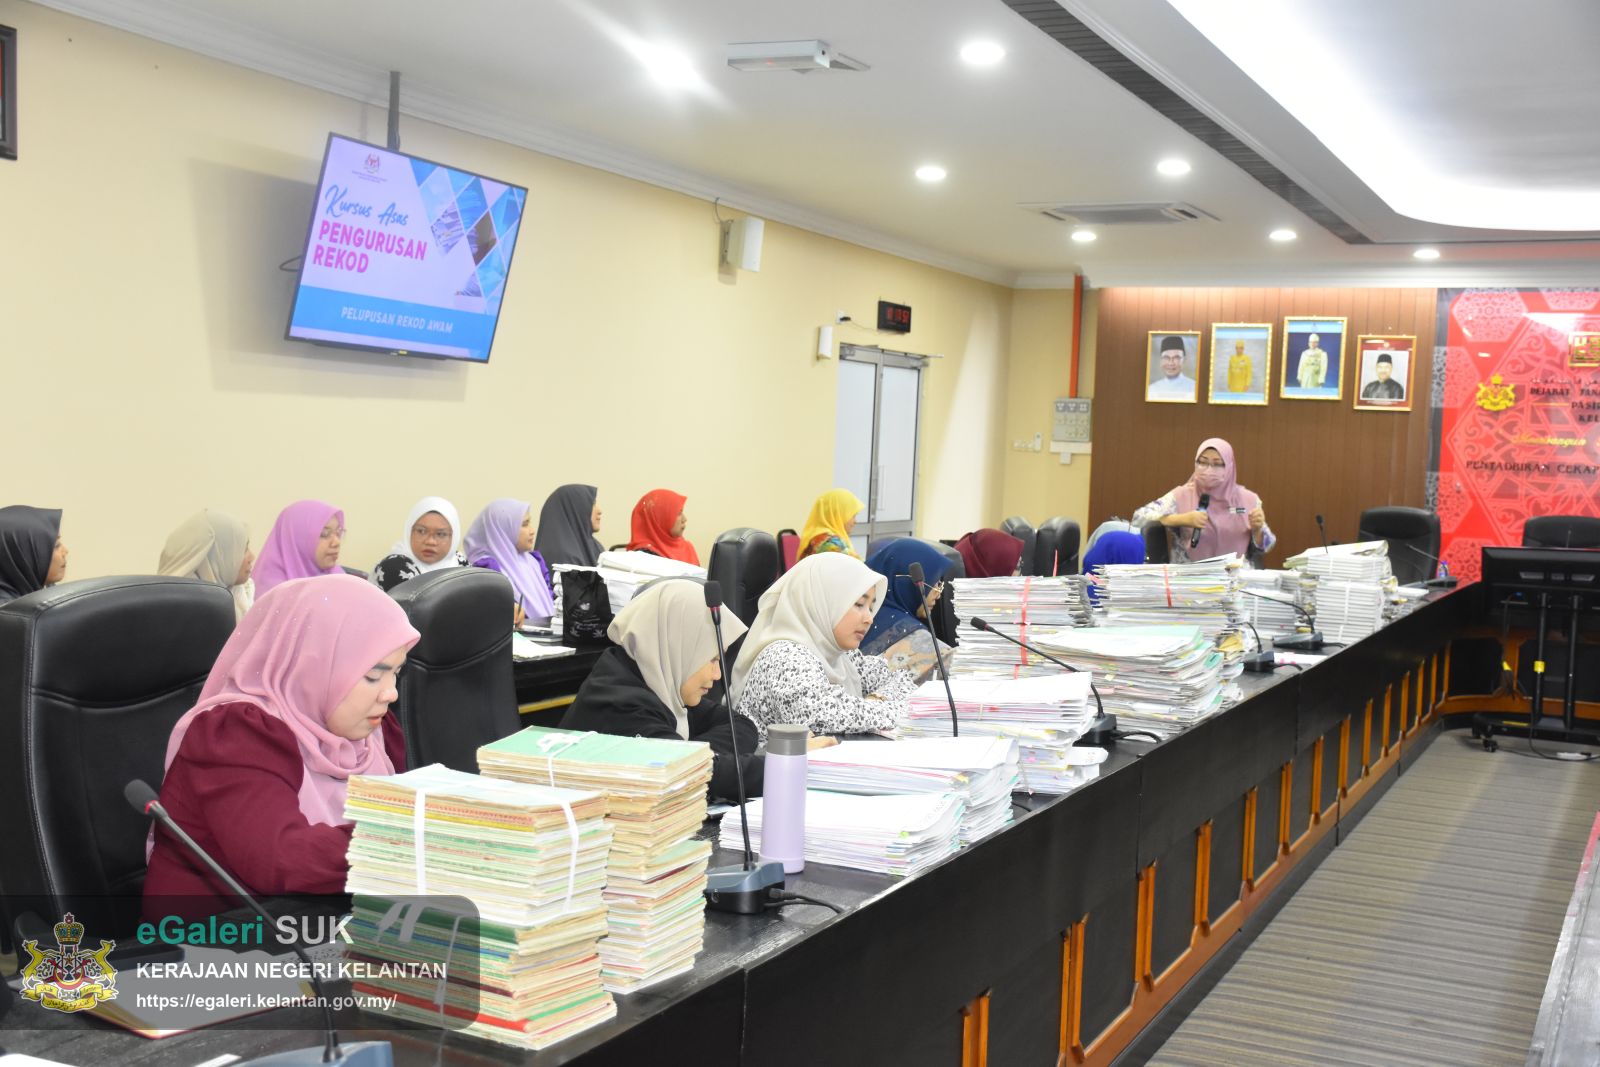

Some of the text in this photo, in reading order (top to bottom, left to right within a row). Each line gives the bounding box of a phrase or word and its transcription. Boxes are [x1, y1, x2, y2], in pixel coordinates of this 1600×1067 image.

[325, 184, 408, 226] Kursus Asas
[318, 219, 427, 261] PENGURUSAN
[312, 244, 369, 273] REKOD
[341, 306, 454, 334] PELUPUSAN REKOD AWAM
